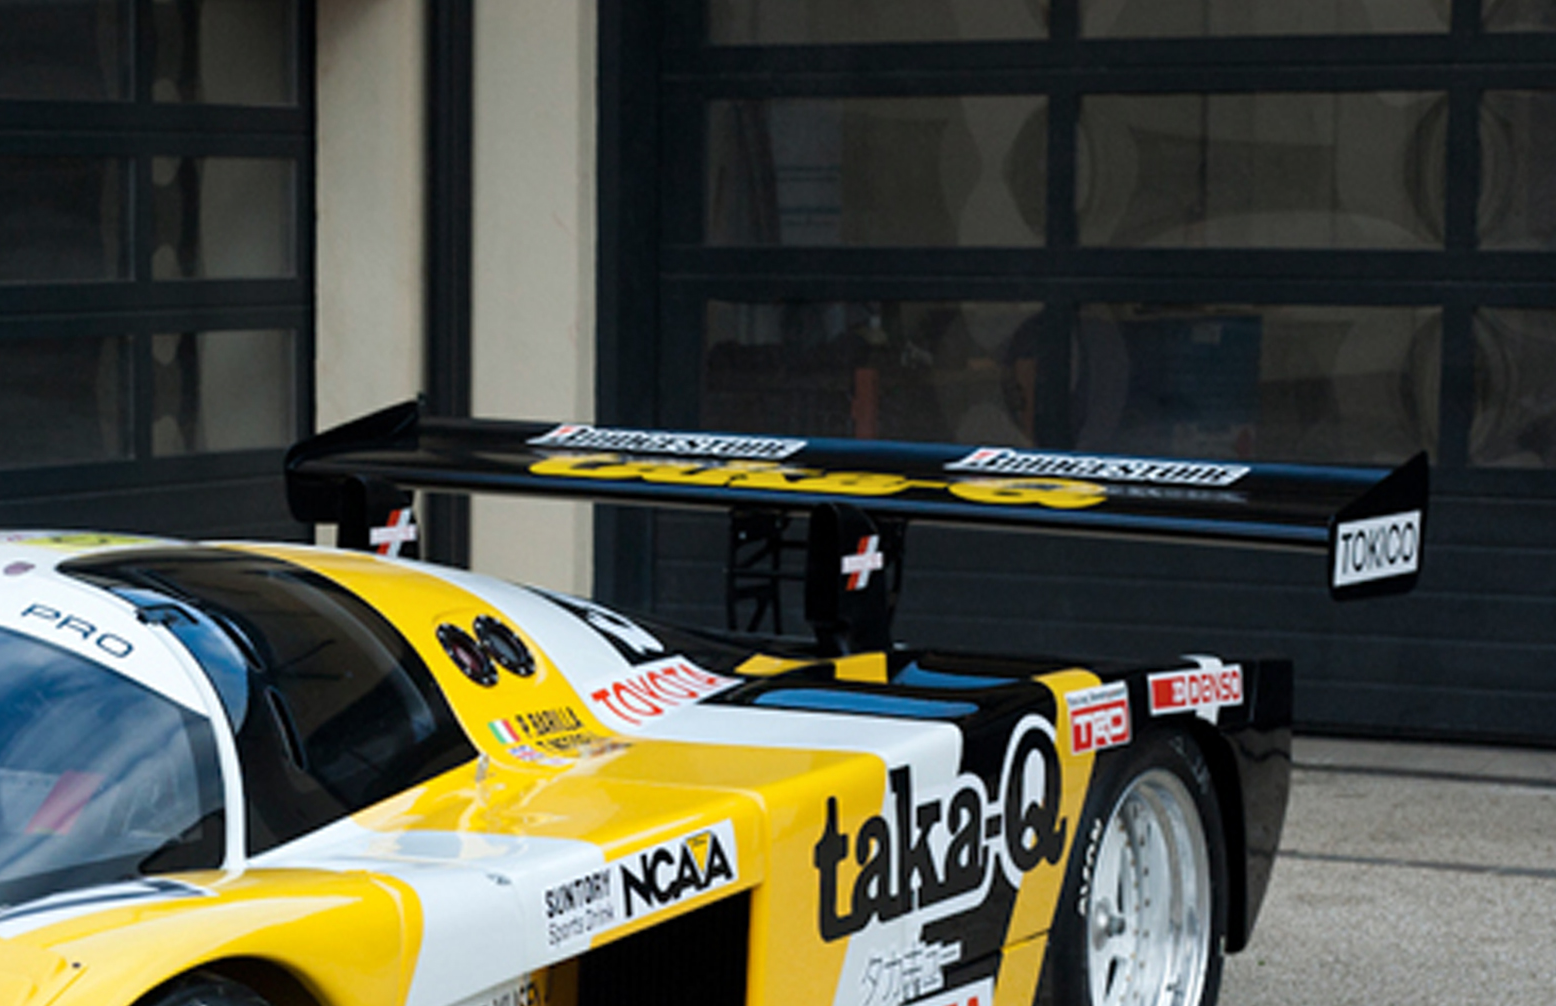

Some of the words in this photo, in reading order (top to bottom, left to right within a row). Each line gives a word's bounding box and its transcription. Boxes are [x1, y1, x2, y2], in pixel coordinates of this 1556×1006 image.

[971, 450, 1234, 482] BRIDGESTONE
[1341, 522, 1418, 576] TOKICO
[21, 603, 134, 659] PRO
[1073, 706, 1127, 752] TRD
[813, 726, 1068, 943] taka-Q
[546, 871, 610, 918] SUNTORY
[619, 831, 733, 917] NCAA
